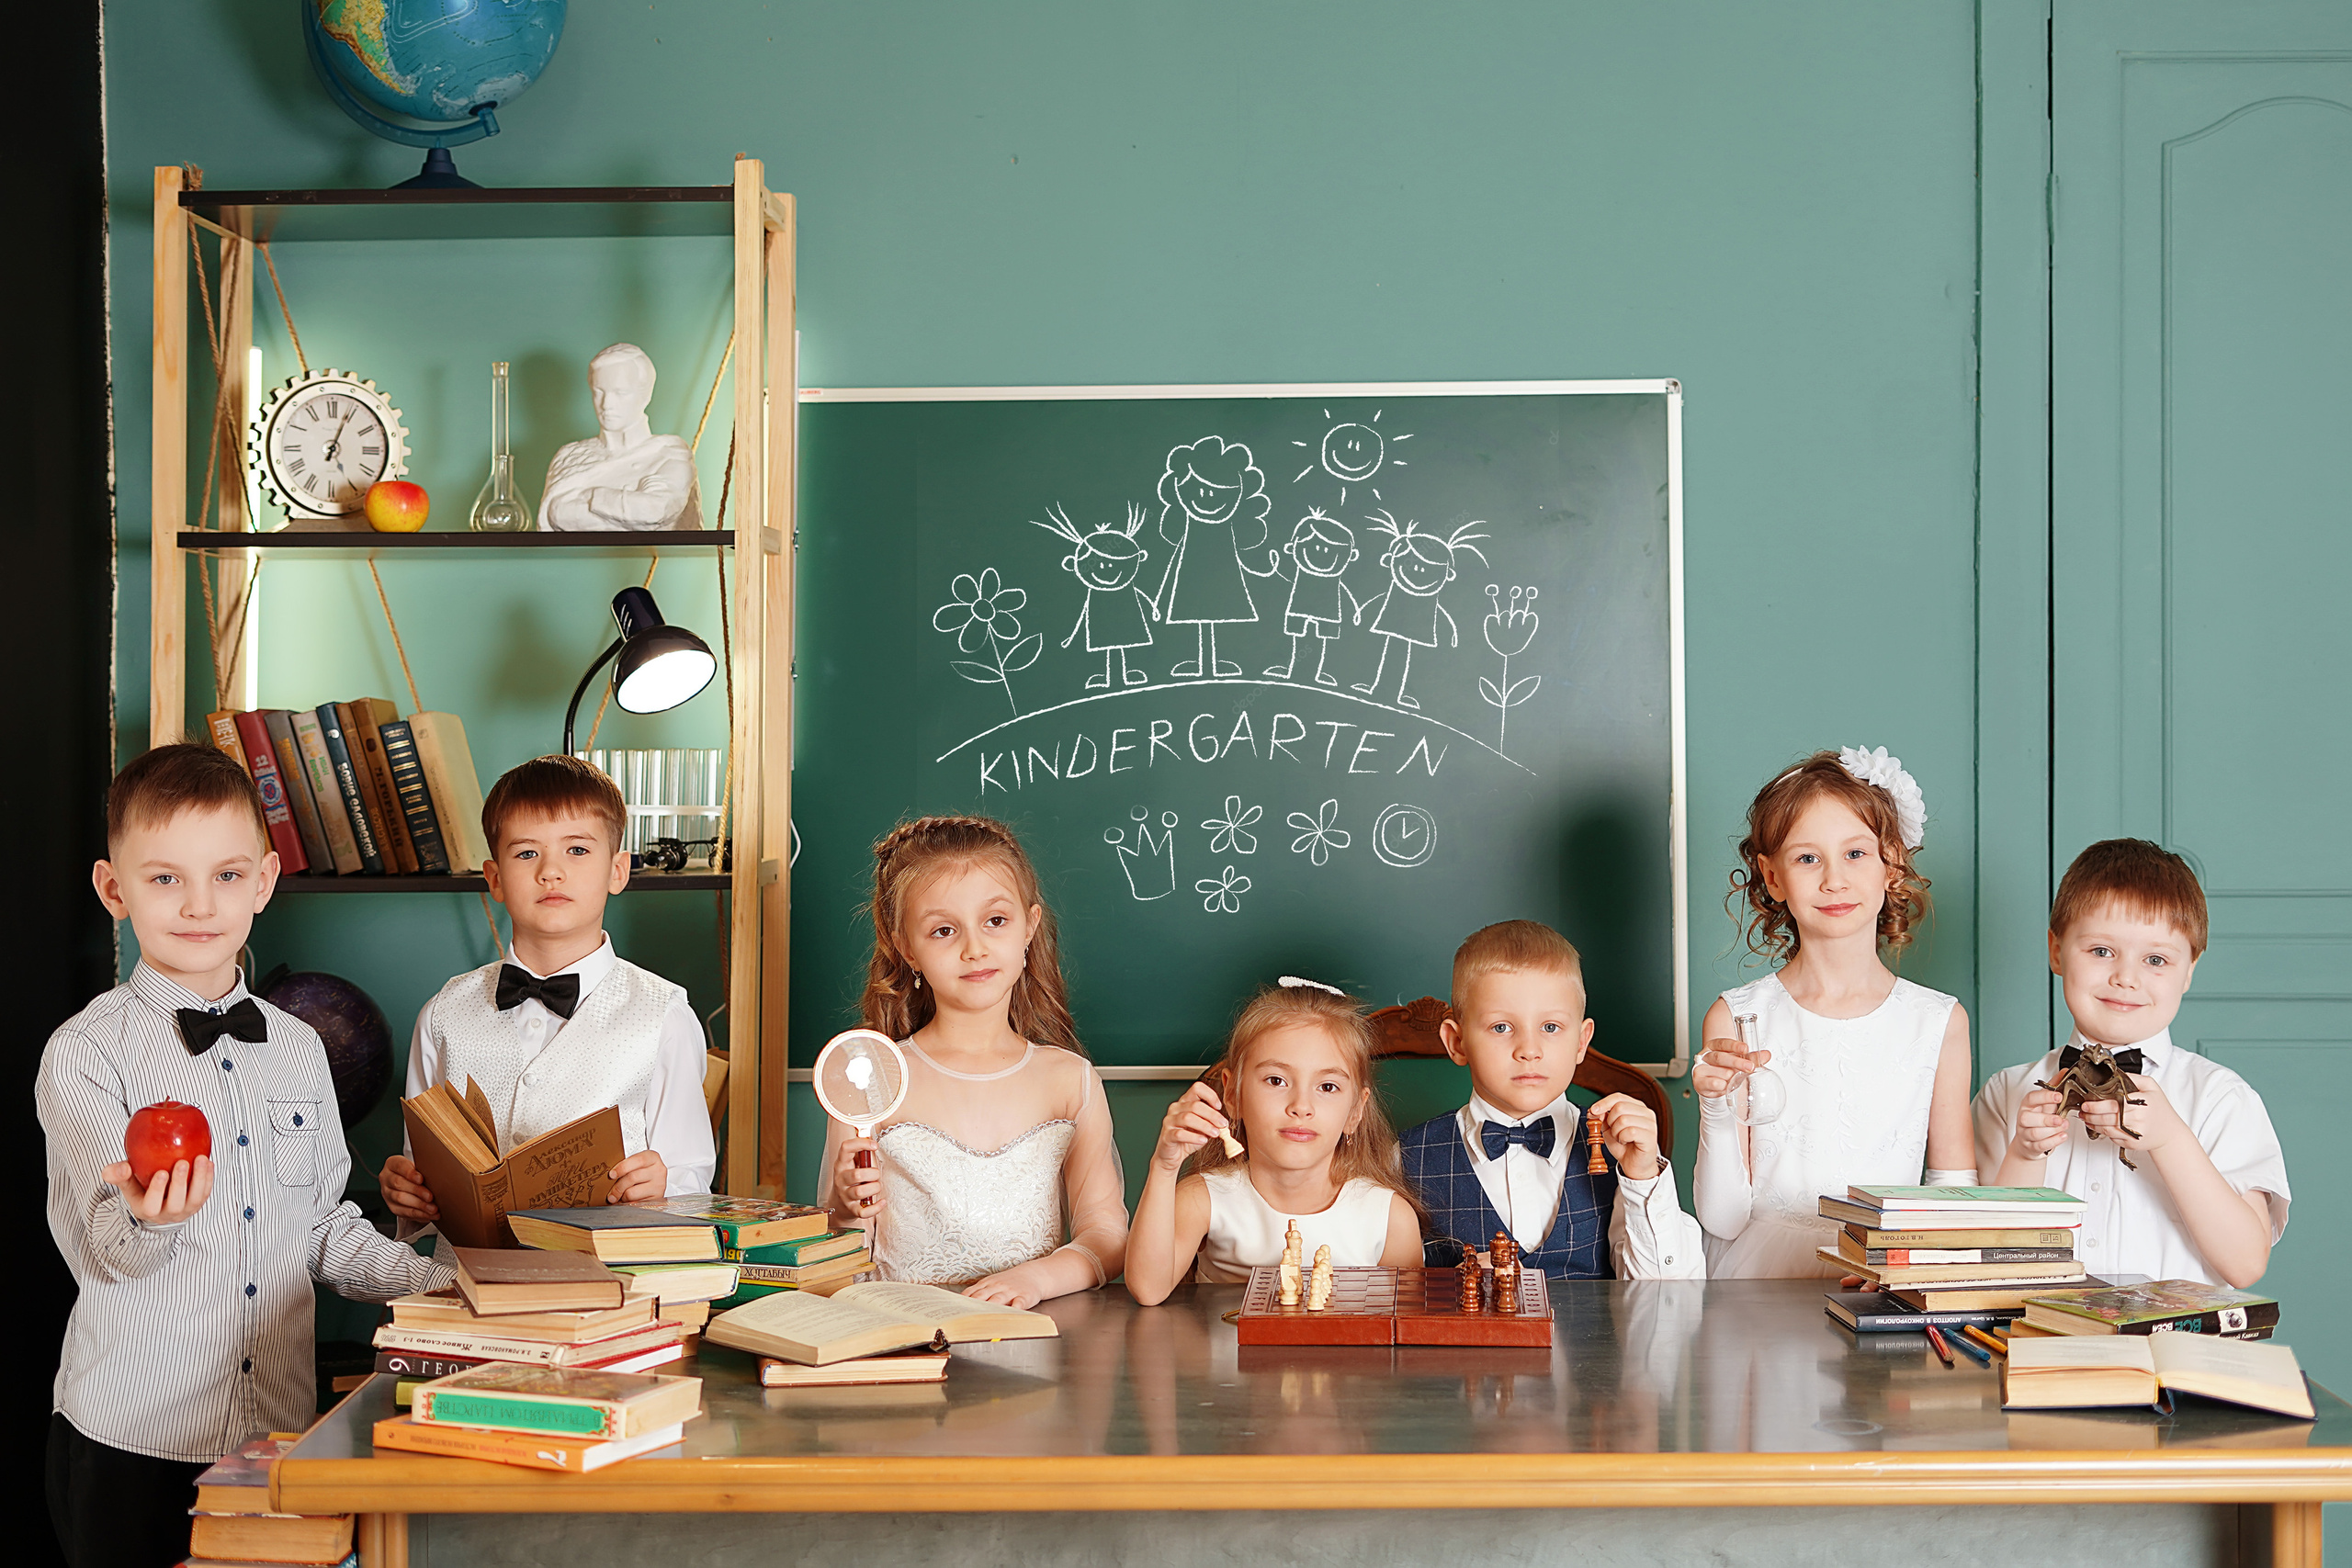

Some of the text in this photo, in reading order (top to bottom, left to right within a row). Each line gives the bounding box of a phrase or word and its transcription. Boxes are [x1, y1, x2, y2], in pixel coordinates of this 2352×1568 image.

[979, 710, 1449, 795] KINDERGARTEN
[337, 761, 356, 796] БОРИС
[349, 797, 377, 858] САДОВСКОЙ
[2038, 1251, 2059, 1259] район
[744, 1267, 791, 1279] ХОТТАБЫЧ
[2175, 1318, 2202, 1333] ВСЕ
[416, 1337, 441, 1346] слово
[441, 1340, 473, 1351] Живое
[436, 1400, 495, 1418] ЦАРСТВЕ
[500, 1405, 586, 1427] ТРИДЕВЯТОМ
